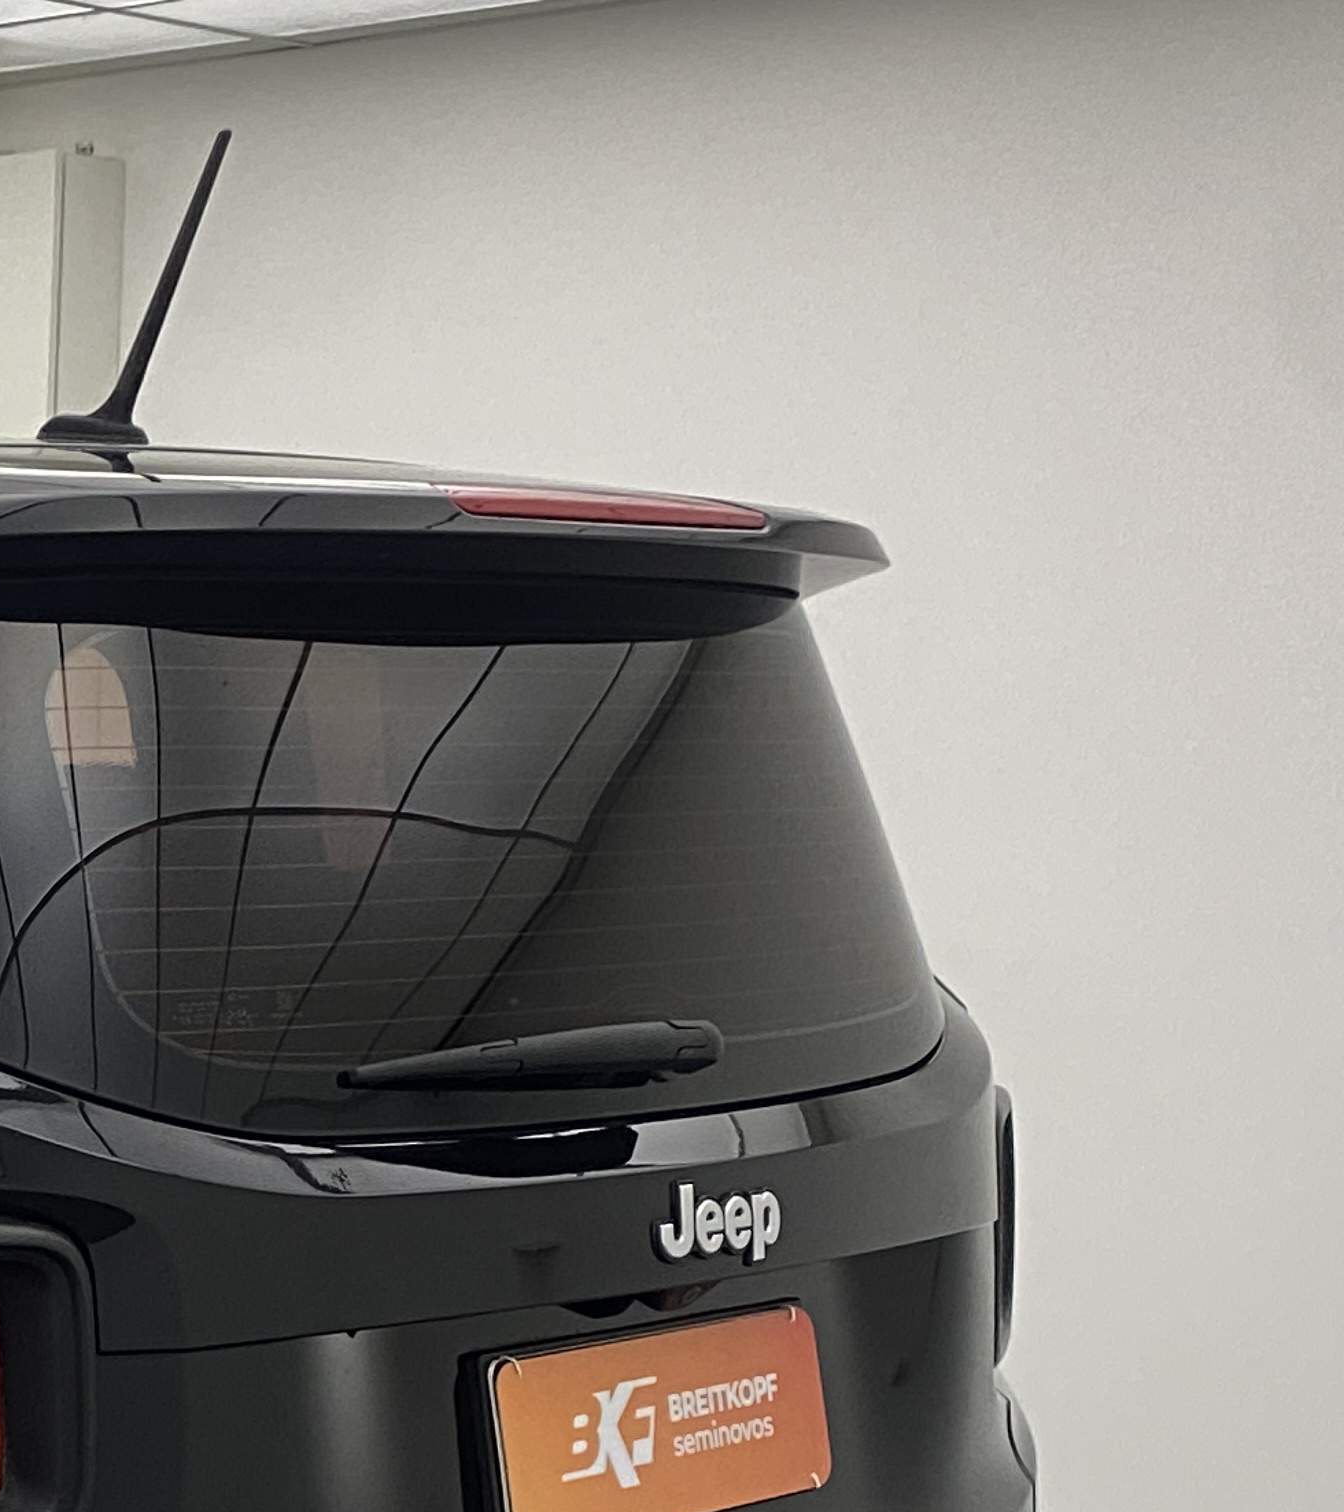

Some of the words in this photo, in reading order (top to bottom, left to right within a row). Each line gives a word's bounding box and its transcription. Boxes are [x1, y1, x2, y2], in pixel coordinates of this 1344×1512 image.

[653, 1180, 782, 1263] Jeep
[666, 1372, 779, 1424] BREITKOPF
[672, 1415, 775, 1458] seminovos
